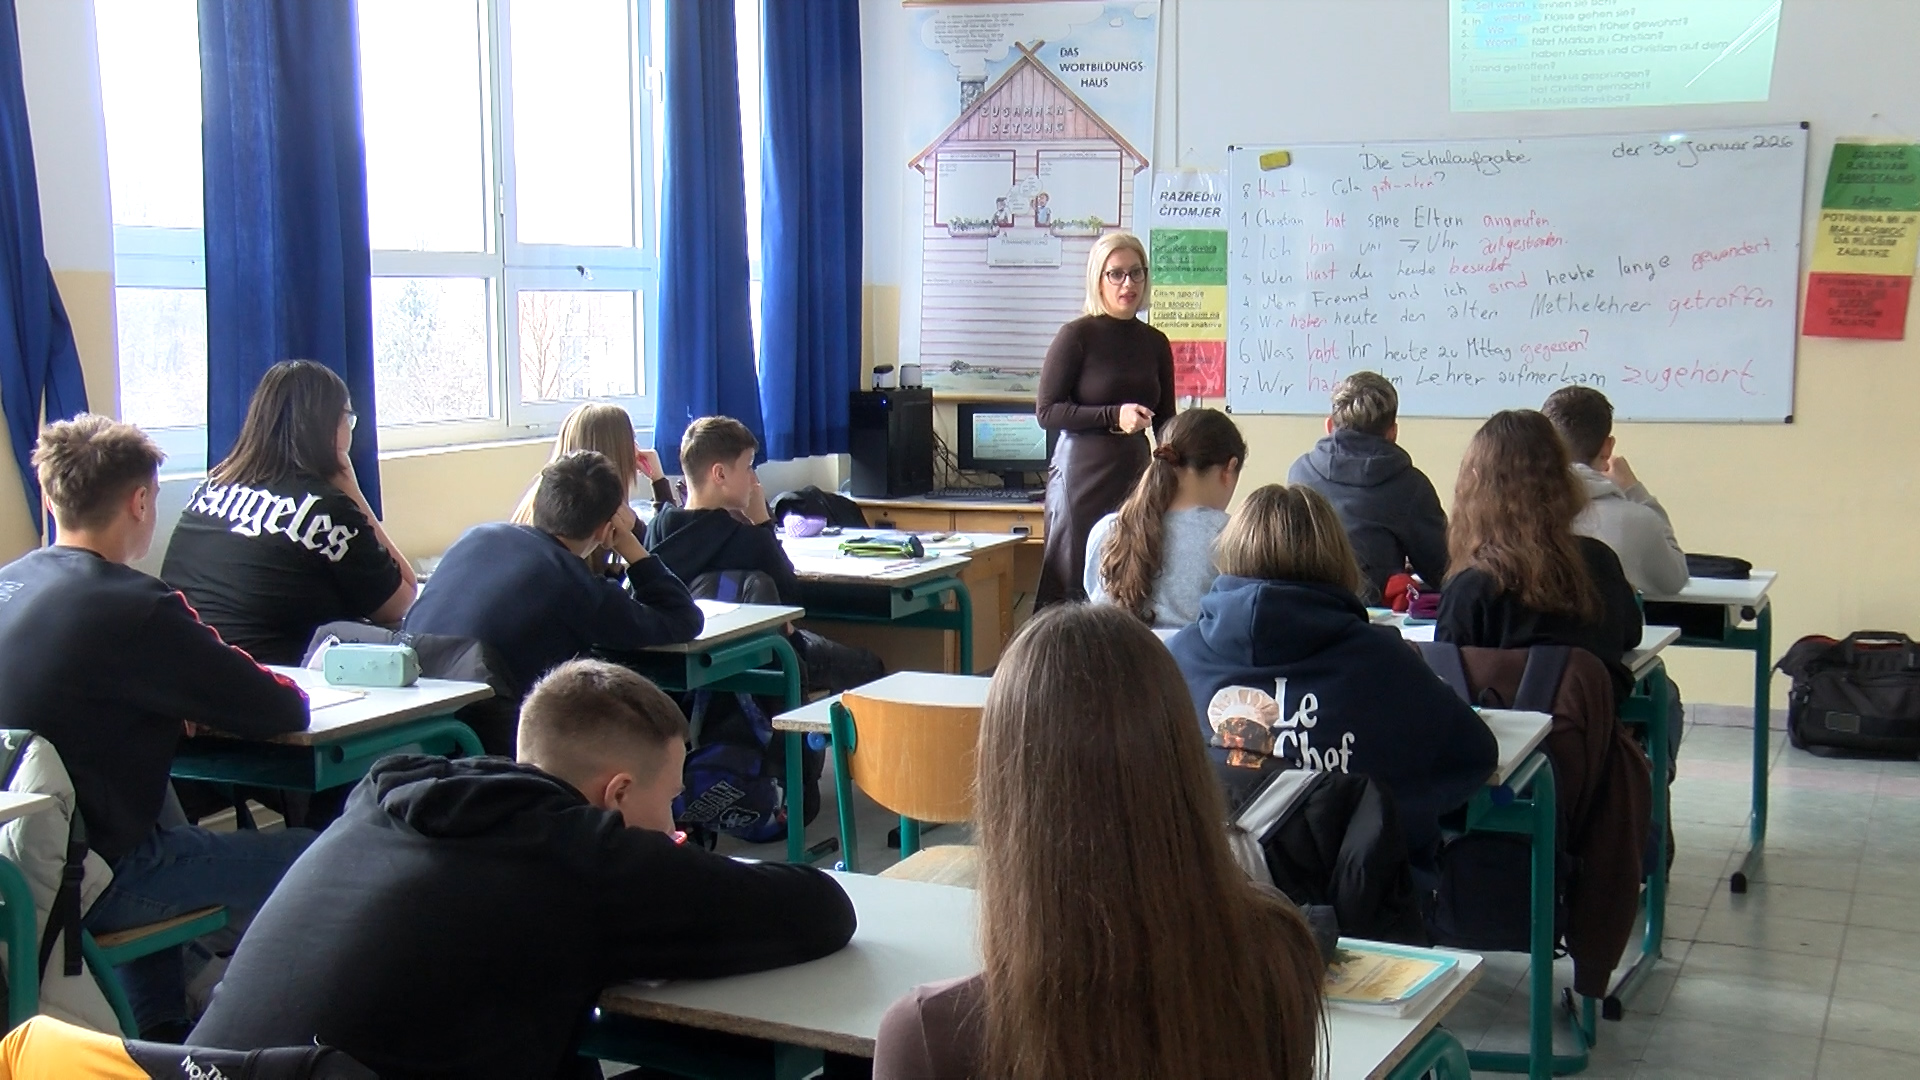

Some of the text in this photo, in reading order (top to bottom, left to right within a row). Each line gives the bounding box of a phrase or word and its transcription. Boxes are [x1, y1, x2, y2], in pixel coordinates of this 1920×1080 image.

[1544, 12, 1575, 21] Klasse
[1578, 10, 1613, 21] gehen
[1532, 26, 1550, 34] hat
[1552, 24, 1596, 34] Christian
[1599, 21, 1630, 30] früher
[1633, 17, 1689, 29] gewohnt?
[1484, 37, 1518, 47] Womit
[1558, 36, 1595, 45] Markus
[1611, 31, 1664, 43] Christian?
[1060, 47, 1079, 58] DAS
[1531, 49, 1565, 59] haben
[1568, 47, 1605, 56] Markus
[1607, 46, 1629, 55] und
[1631, 43, 1677, 54] Christian
[1680, 41, 1699, 51] auf
[1059, 61, 1146, 72] WORTBILDUNGS-
[1503, 61, 1556, 74] getroffen?
[1080, 77, 1109, 88] HAUS
[1581, 69, 1651, 82] gesprungen?
[1550, 84, 1594, 94] Christian
[1597, 81, 1651, 93] gemacht?
[991, 122, 1065, 134] SETZUNG
[1359, 149, 1531, 176] Die Schulaufgabe
[1612, 142, 1644, 158] der
[1677, 141, 1749, 168] Januar
[1159, 191, 1222, 202] RAZREDNI
[1159, 204, 1222, 218] ČITOMJER
[1256, 207, 1304, 228] Christian
[1325, 209, 1347, 228] hat
[1368, 212, 1400, 230] seine
[1414, 205, 1464, 228] Eltern
[1823, 213, 1884, 223] POTREBNA
[1829, 225, 1859, 235] MALA
[1261, 234, 1291, 259] Ich
[1310, 234, 1335, 254] bin
[1427, 230, 1458, 254] Uhr
[1261, 269, 1292, 285] Wen
[1306, 261, 1339, 281] hast
[1350, 263, 1373, 280] du
[1311, 286, 1369, 307] Freund
[1388, 284, 1420, 300] und
[1443, 284, 1468, 298] ich
[1488, 271, 1529, 294] sind
[1547, 264, 1595, 286] heute
[1618, 255, 1671, 282] lange
[1334, 308, 1378, 325] heute
[1400, 308, 1426, 323] den
[1258, 338, 1294, 362] Was
[1307, 333, 1341, 364] habt
[1348, 329, 1373, 360] ihr
[1384, 335, 1428, 362] heute
[1437, 345, 1459, 360] zu
[1257, 369, 1294, 397] Wir
[1308, 363, 1342, 392] hab
[1415, 361, 1486, 387] Lehrer
[1272, 677, 1319, 729] Le
[1272, 729, 1356, 774] Chef
